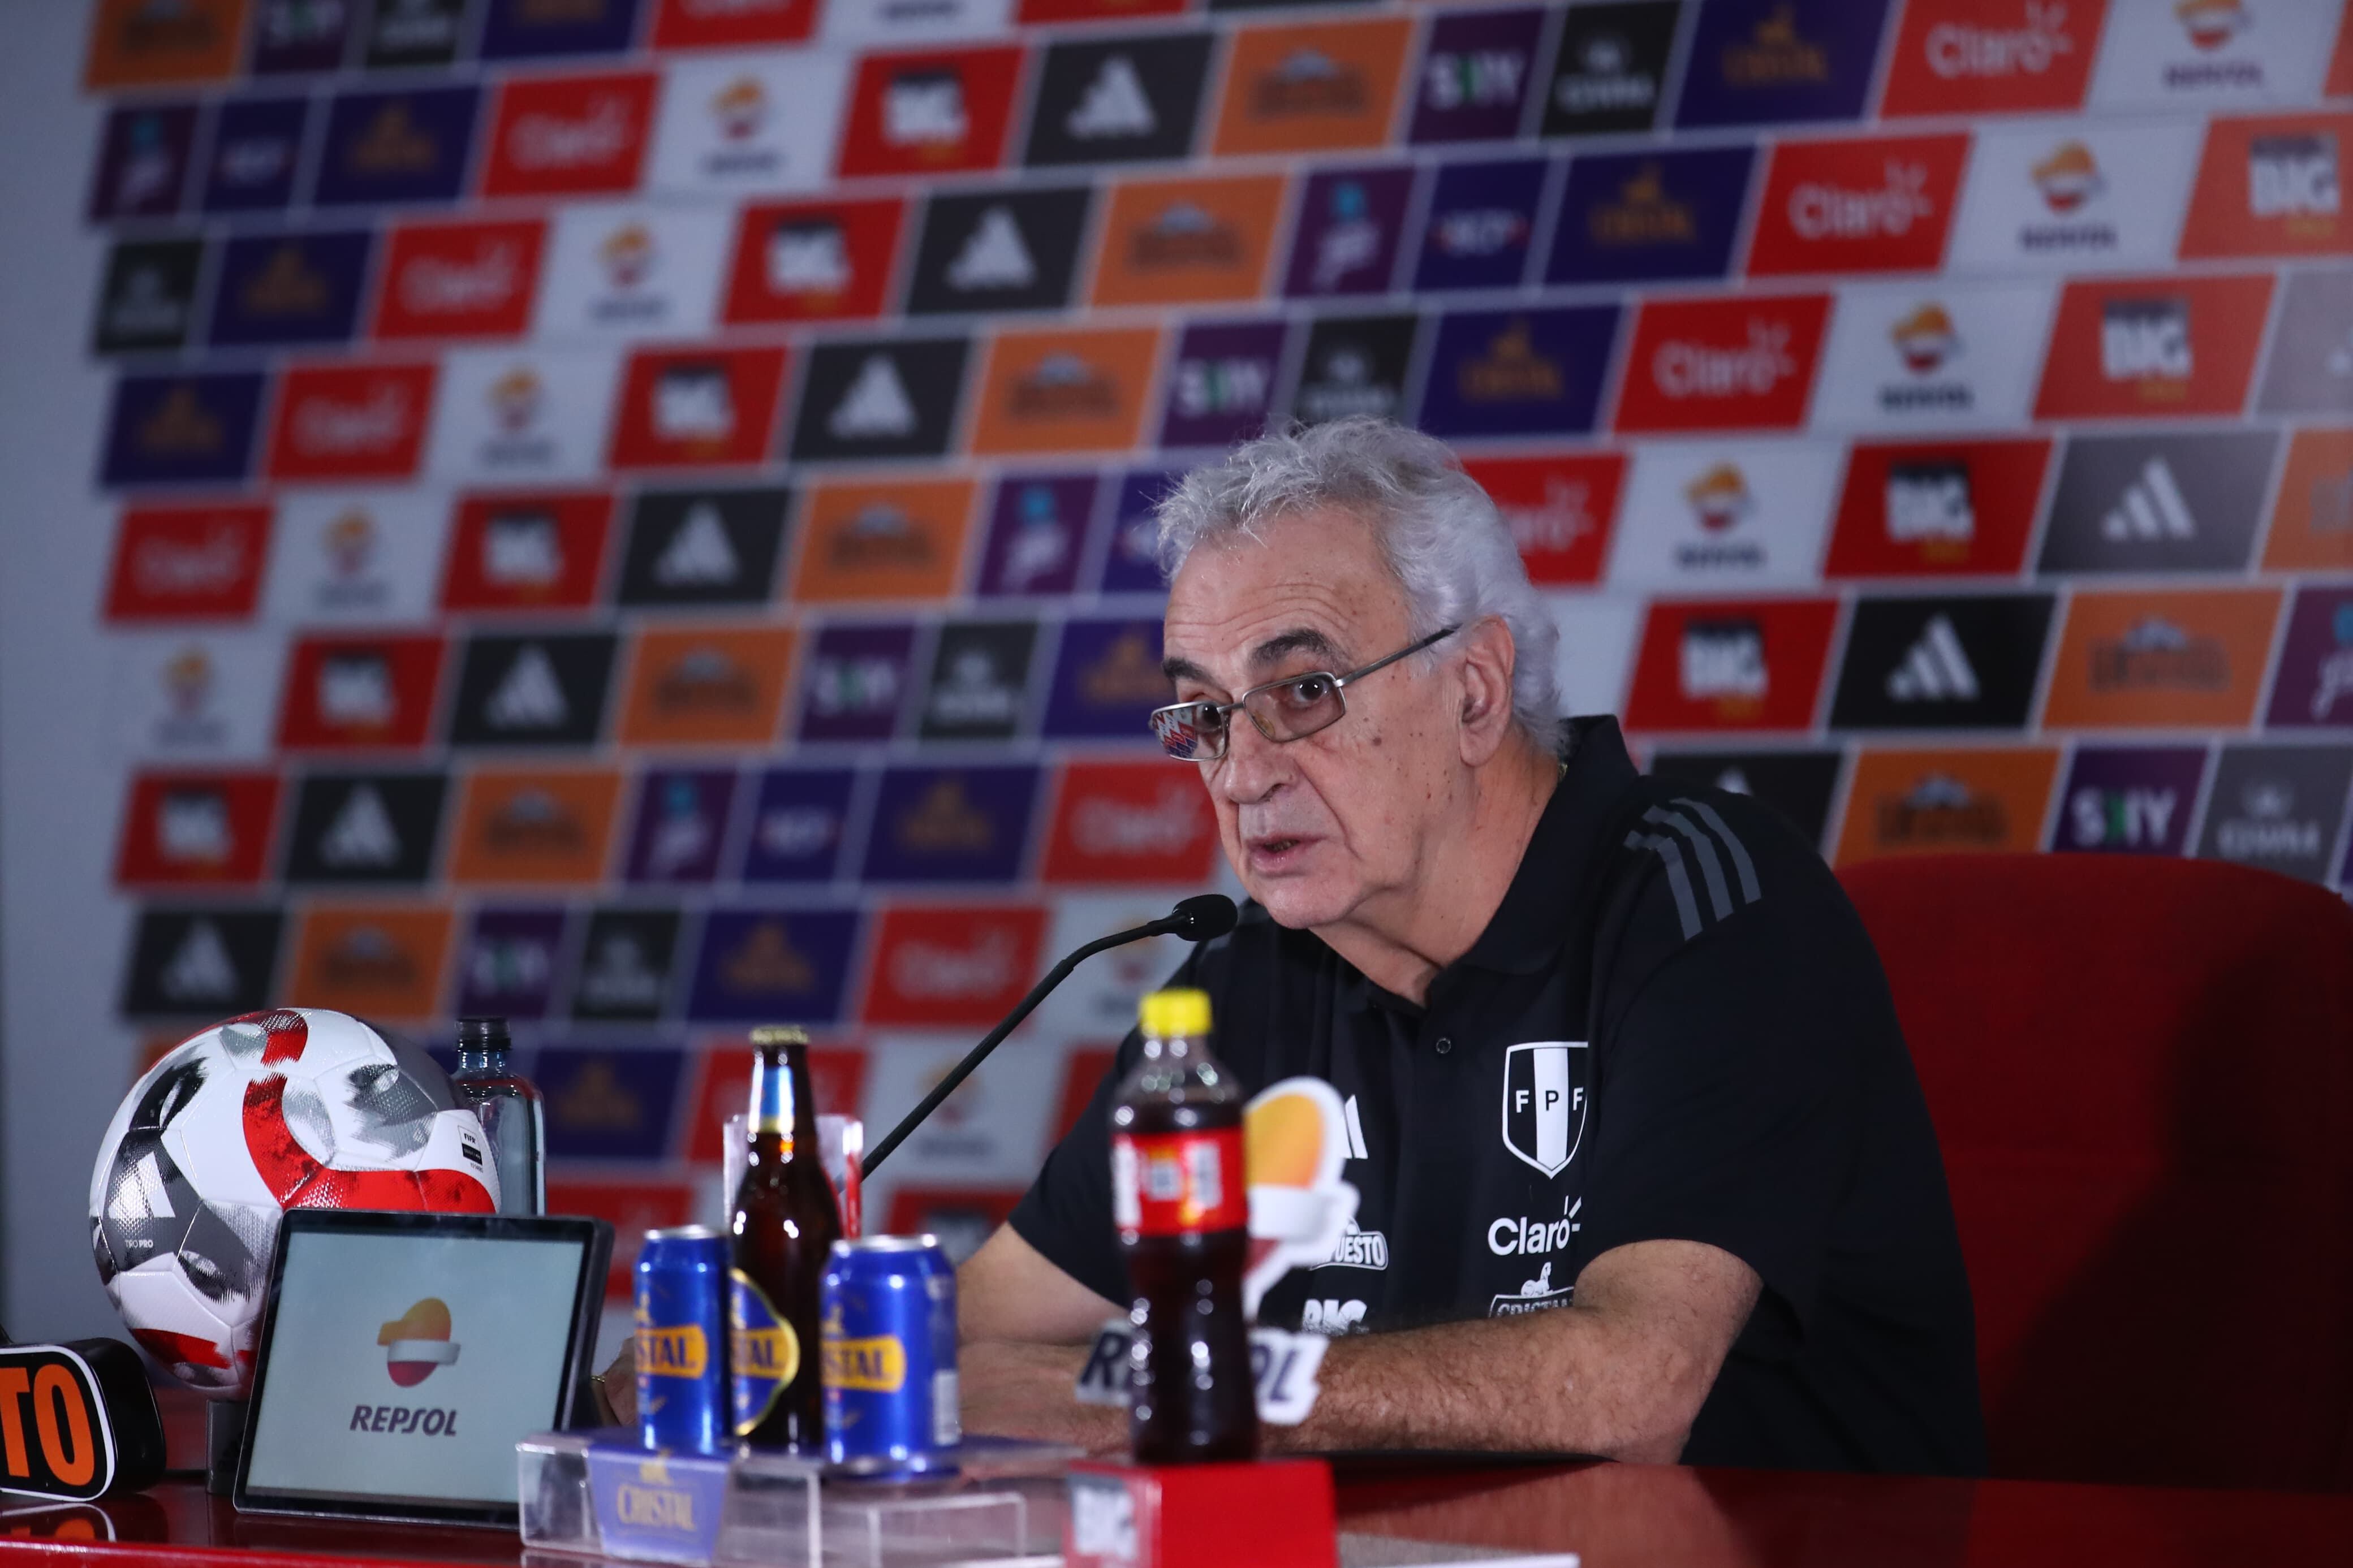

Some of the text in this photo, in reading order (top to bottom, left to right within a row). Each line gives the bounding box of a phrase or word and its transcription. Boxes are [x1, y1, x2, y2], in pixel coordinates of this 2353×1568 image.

[139, 1239, 154, 1249] PRO
[1488, 1216, 1571, 1256] Claro
[350, 1404, 457, 1436] REPSOL
